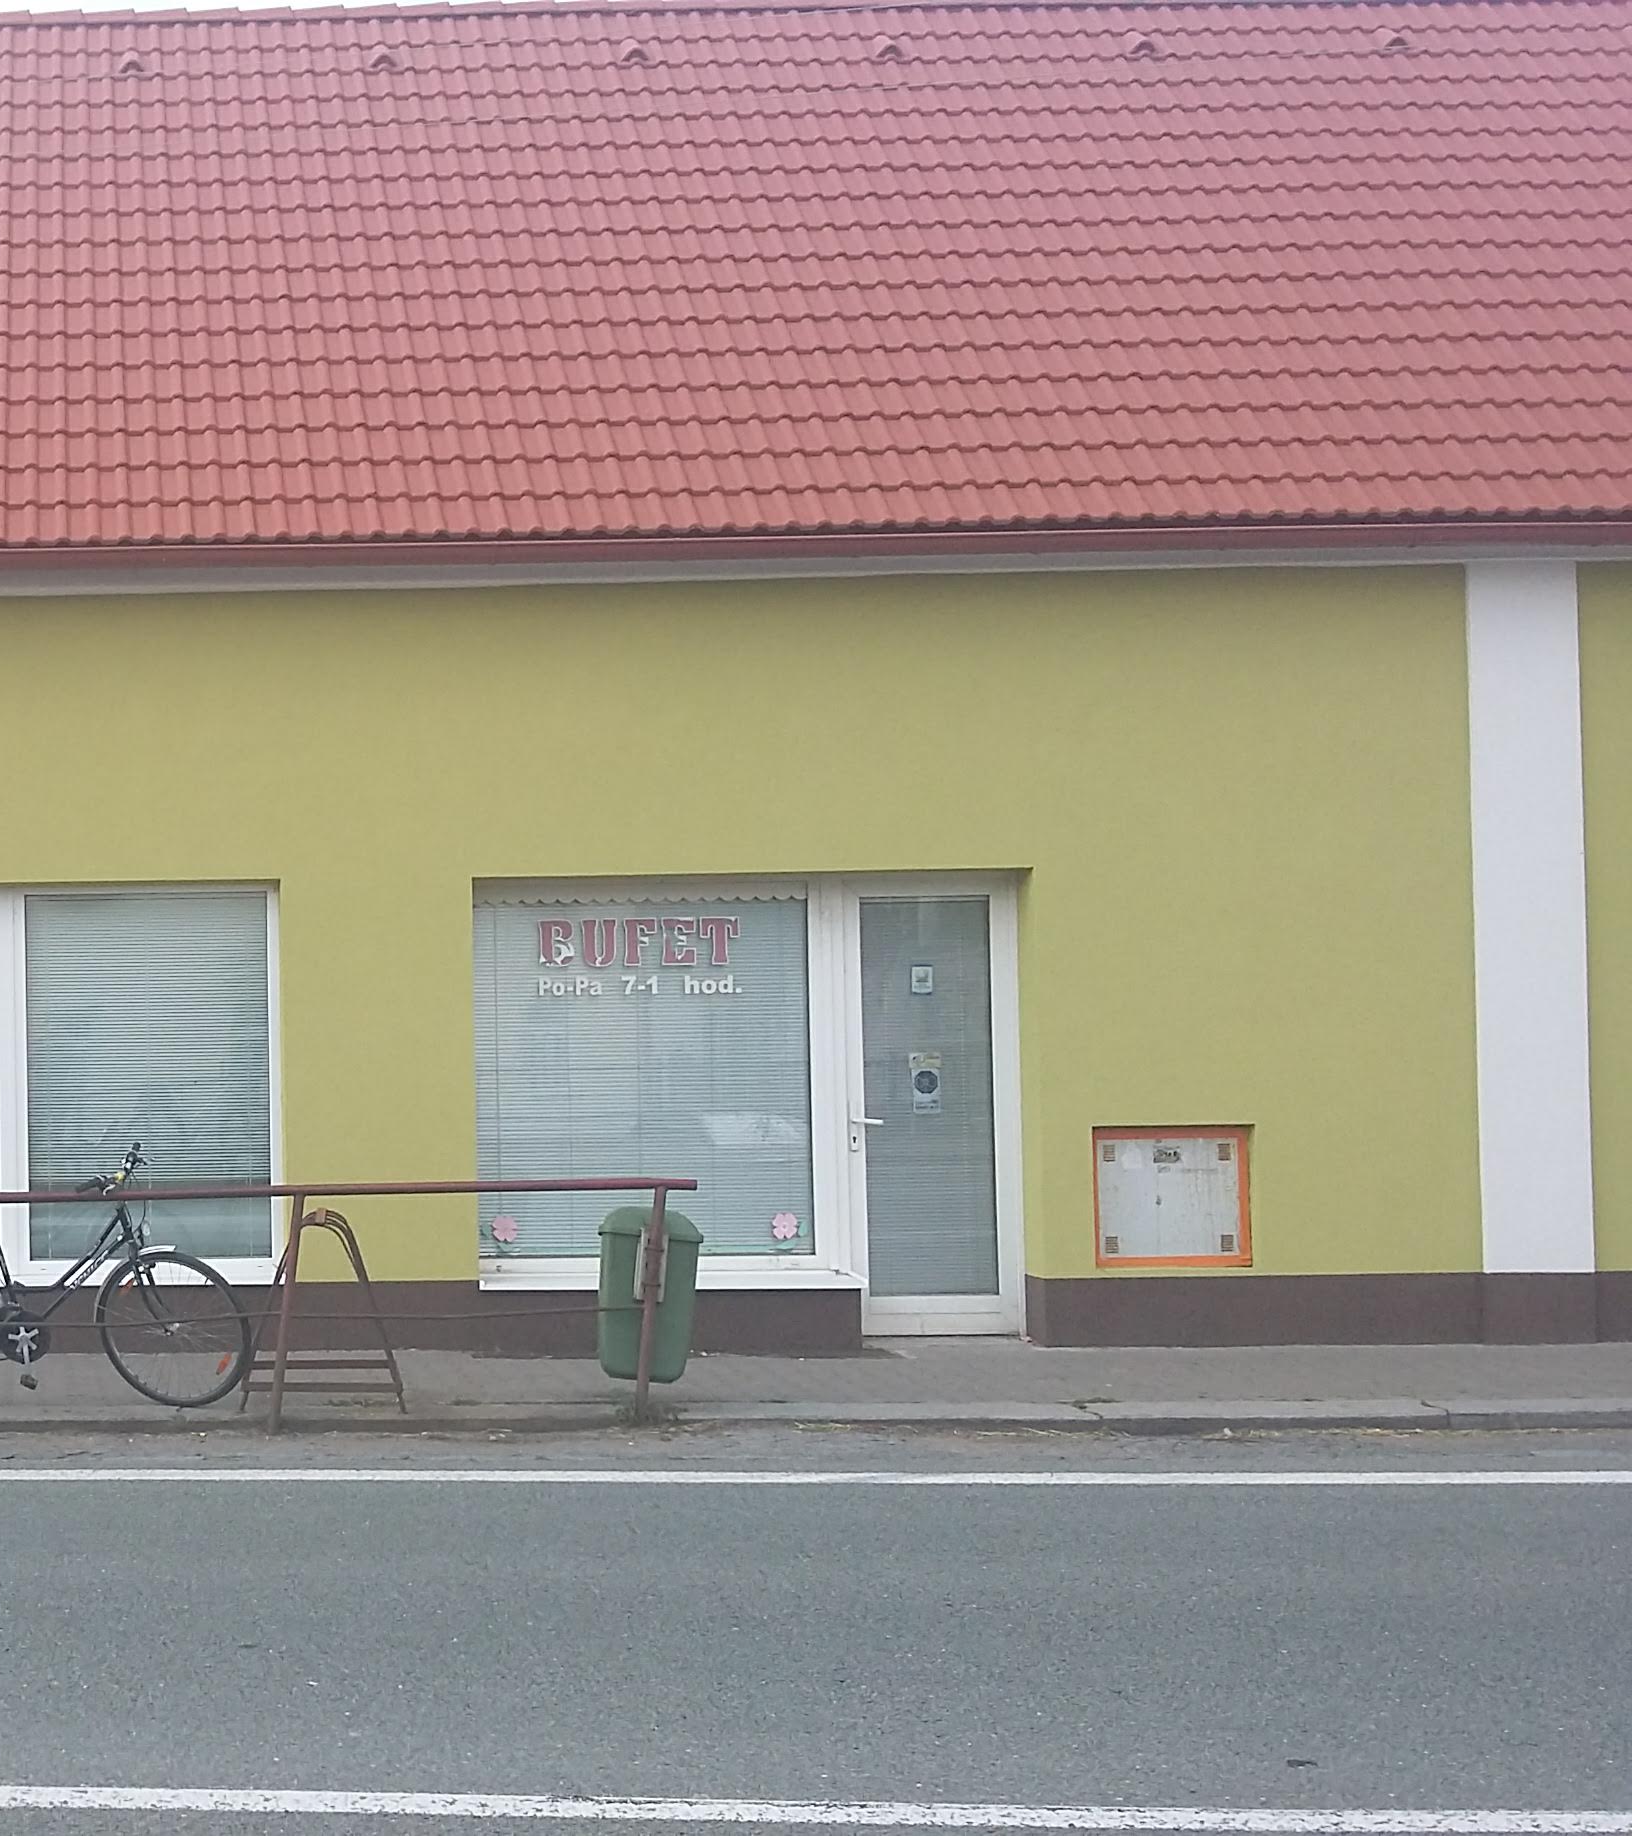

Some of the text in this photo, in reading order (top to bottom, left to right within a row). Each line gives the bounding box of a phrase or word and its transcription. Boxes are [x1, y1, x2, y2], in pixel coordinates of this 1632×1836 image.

[537, 916, 741, 967] BUFET
[538, 975, 743, 997] Po-Pa 7-1 hod.
